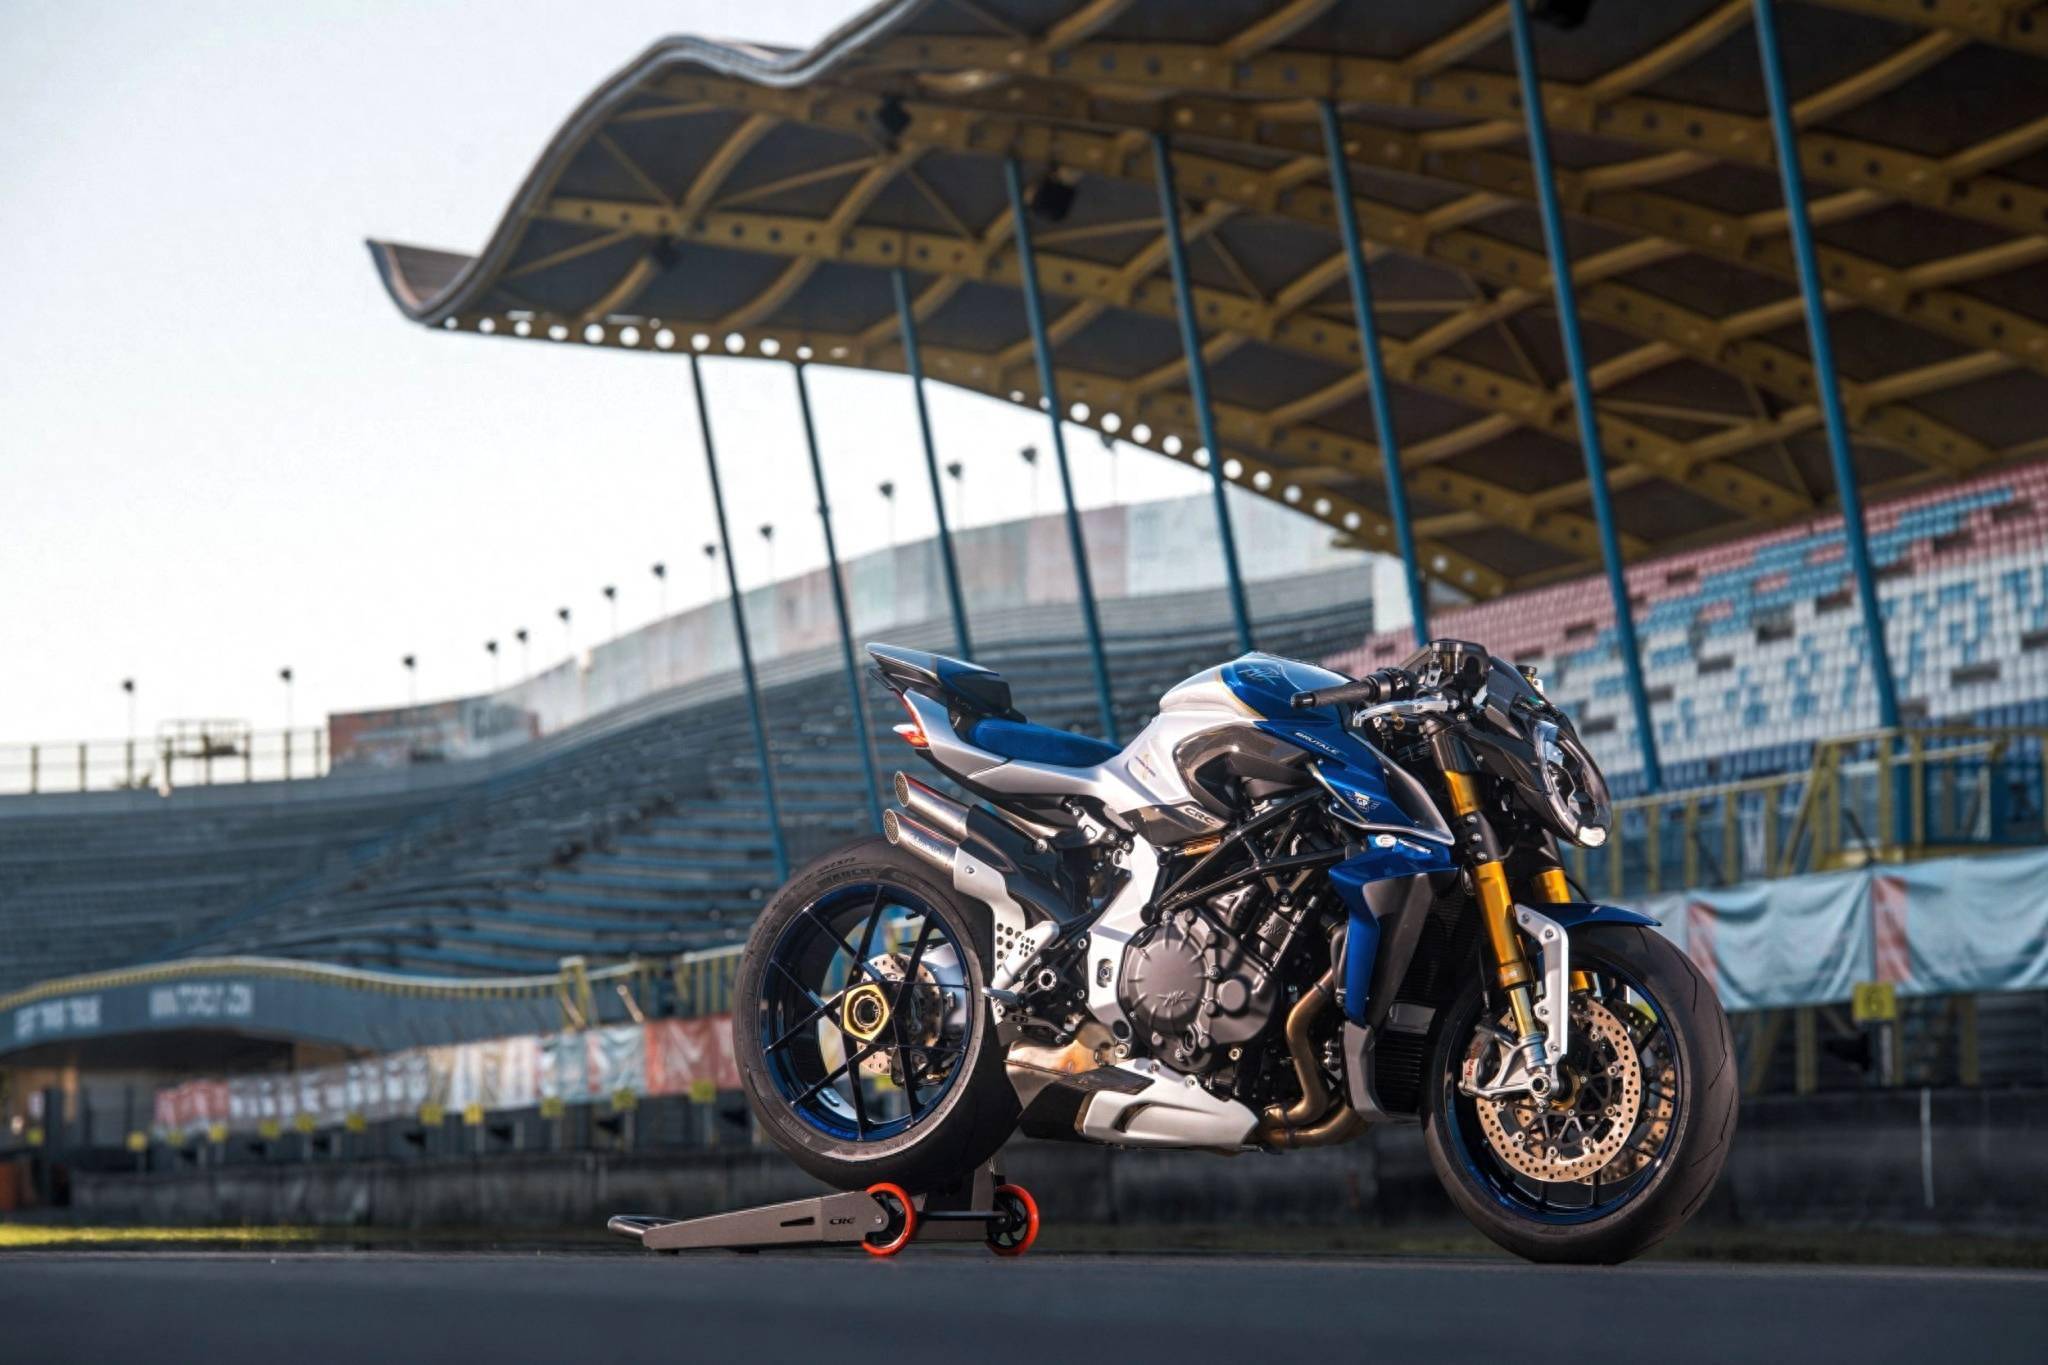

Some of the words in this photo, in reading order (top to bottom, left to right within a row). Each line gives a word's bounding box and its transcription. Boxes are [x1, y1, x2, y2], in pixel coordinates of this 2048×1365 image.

[1295, 732, 1339, 755] BRUTALE
[1185, 807, 1215, 825] CRC
[829, 1217, 856, 1225] CRC
